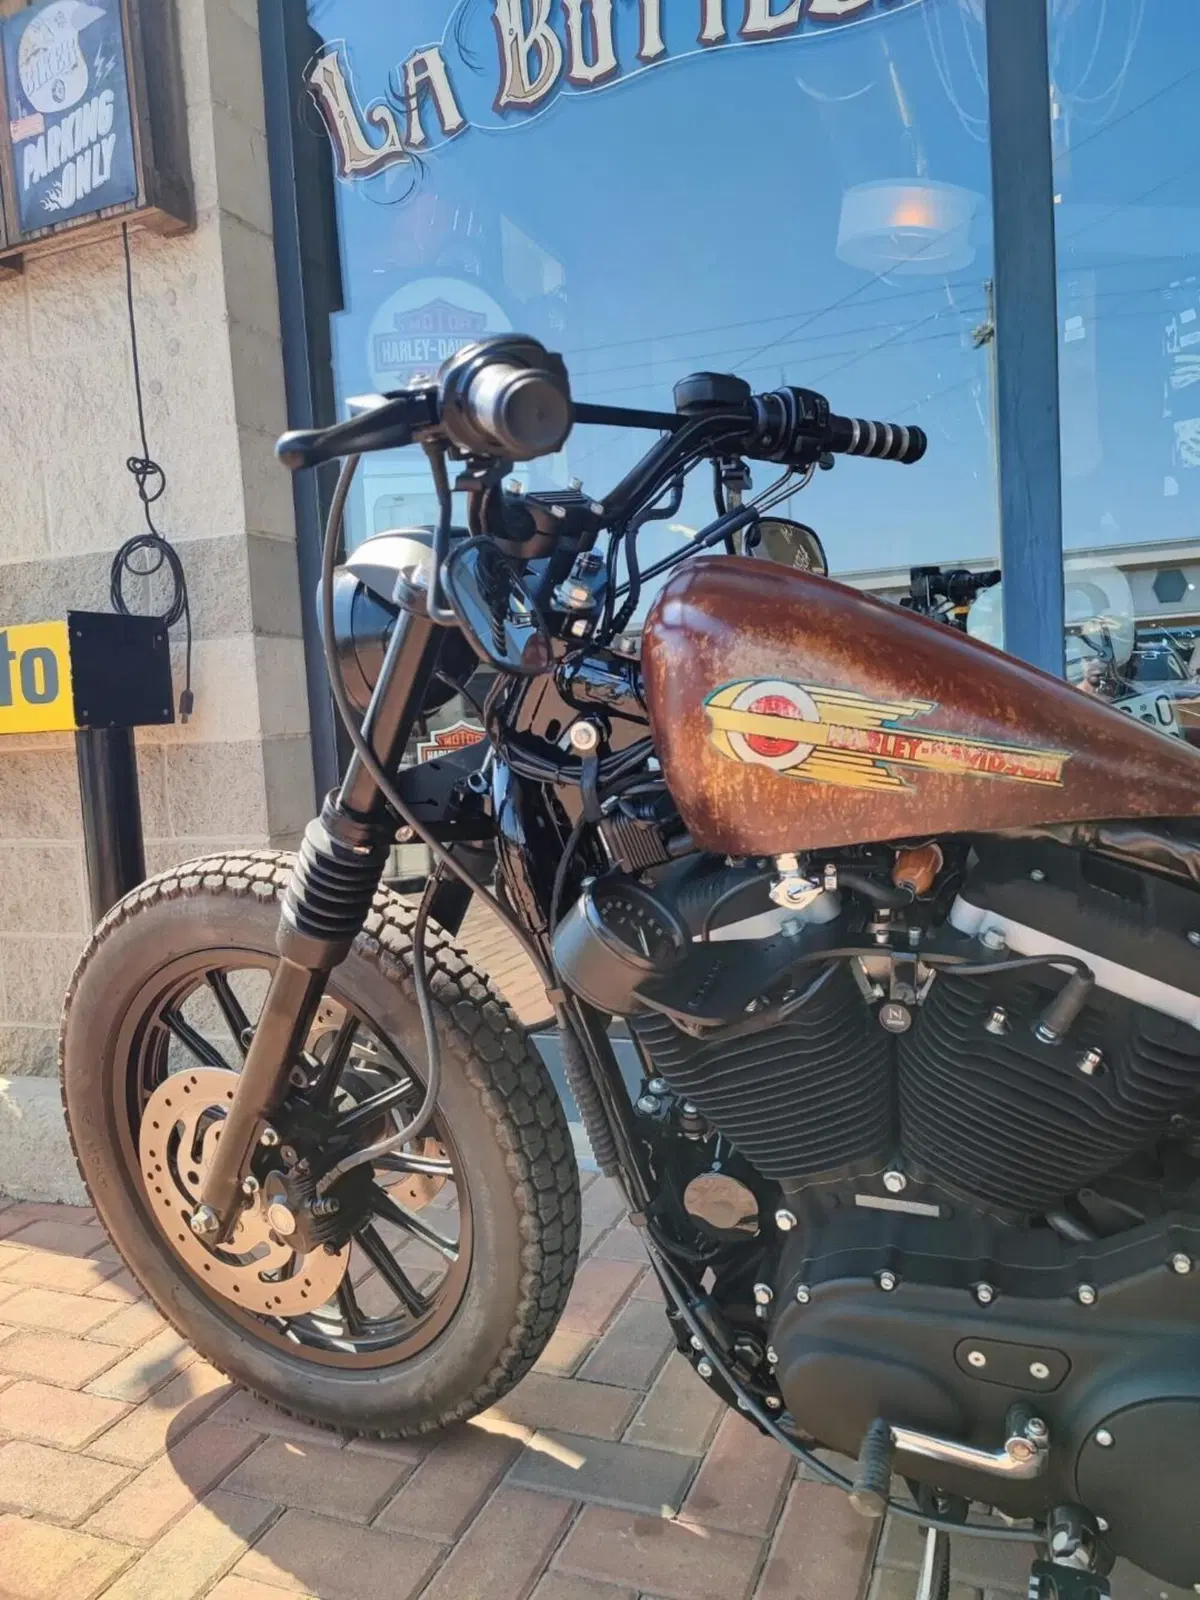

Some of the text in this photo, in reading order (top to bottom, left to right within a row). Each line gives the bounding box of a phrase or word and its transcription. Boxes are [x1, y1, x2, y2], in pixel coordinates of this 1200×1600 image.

[23, 88, 115, 191] PARKING
[309, 45, 469, 178] LA
[57, 132, 116, 210] ONLY
